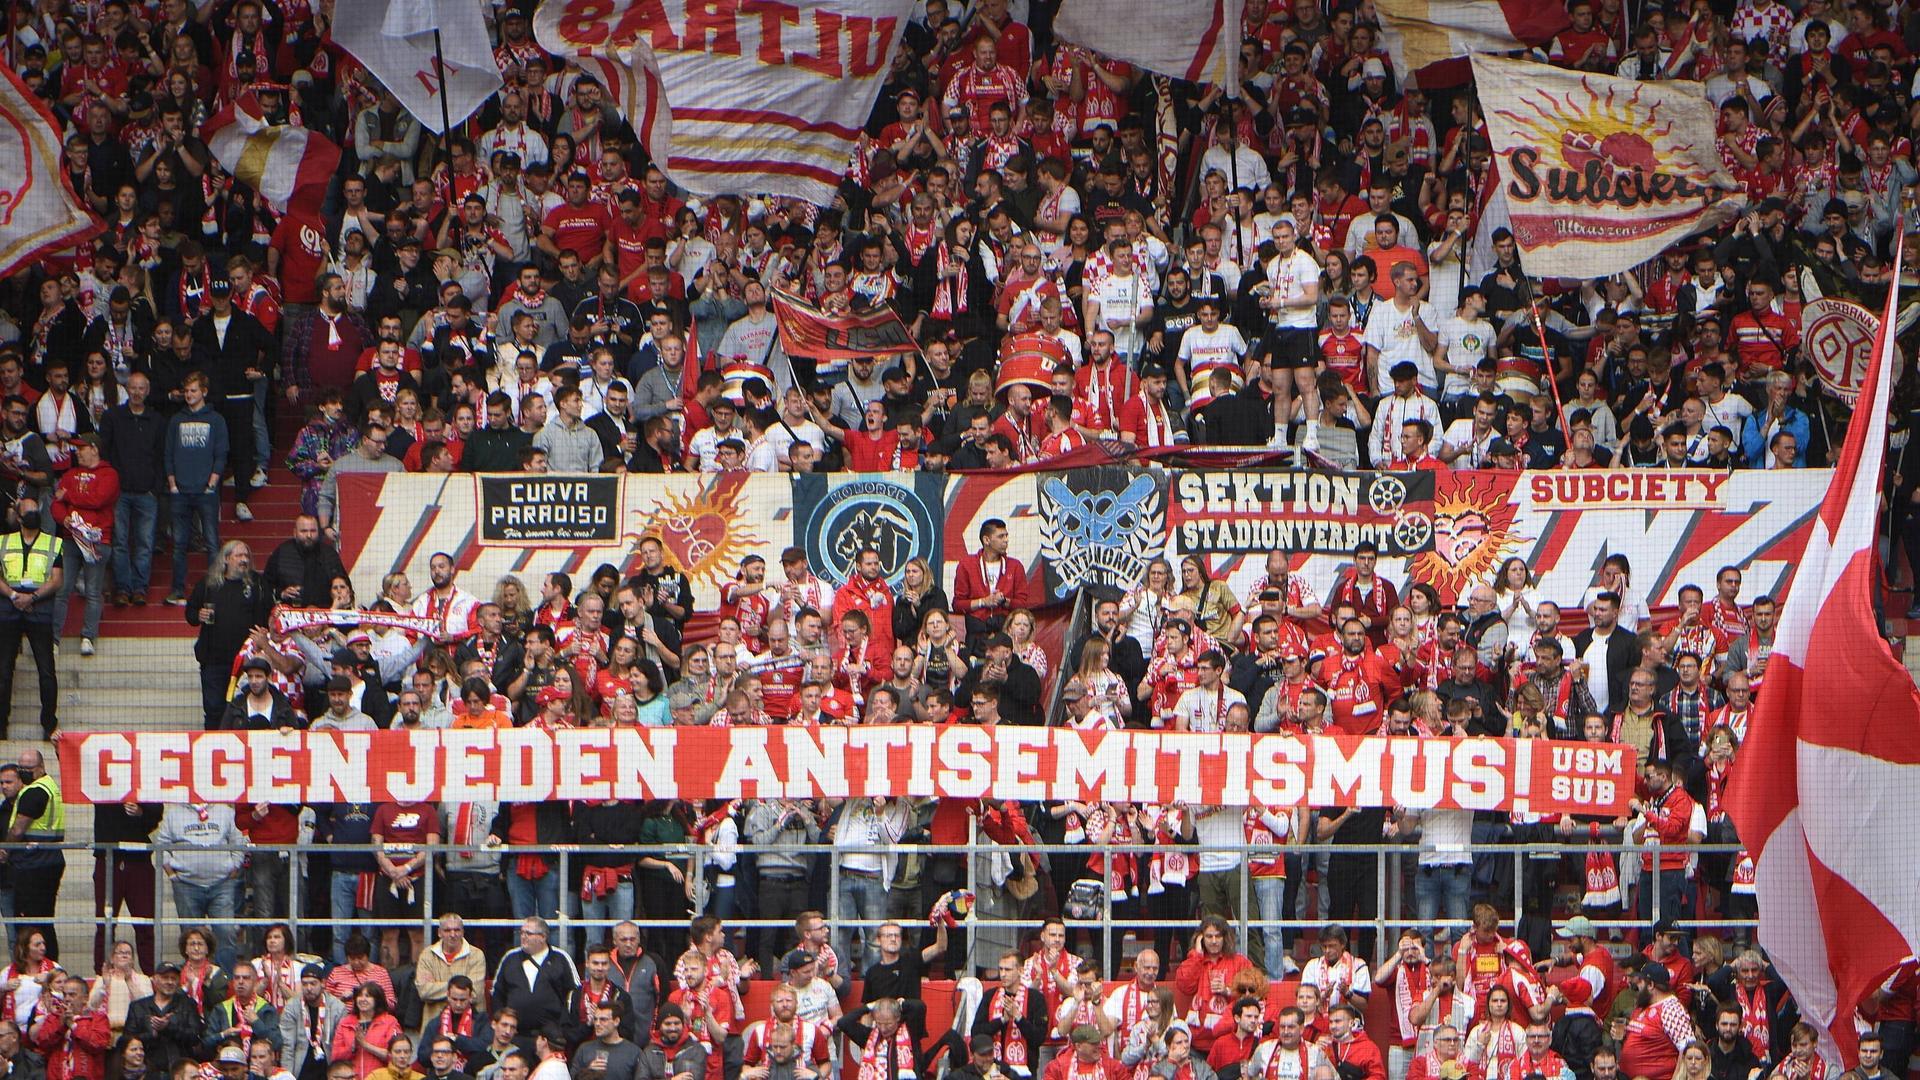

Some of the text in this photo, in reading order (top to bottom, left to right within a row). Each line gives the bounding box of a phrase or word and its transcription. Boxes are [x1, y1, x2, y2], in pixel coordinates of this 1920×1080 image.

[510, 482, 588, 503] CURVA
[1179, 472, 1360, 516] SEKTION
[1531, 473, 1728, 503] SUBCIETY
[491, 504, 607, 525] PARADISO
[1182, 518, 1392, 552] STADIONVERBOT
[80, 724, 1533, 812] GEGEN JEDEN ANTISEMITISMUS!
[1552, 746, 1623, 775] USM
[1551, 775, 1616, 806] SUB
